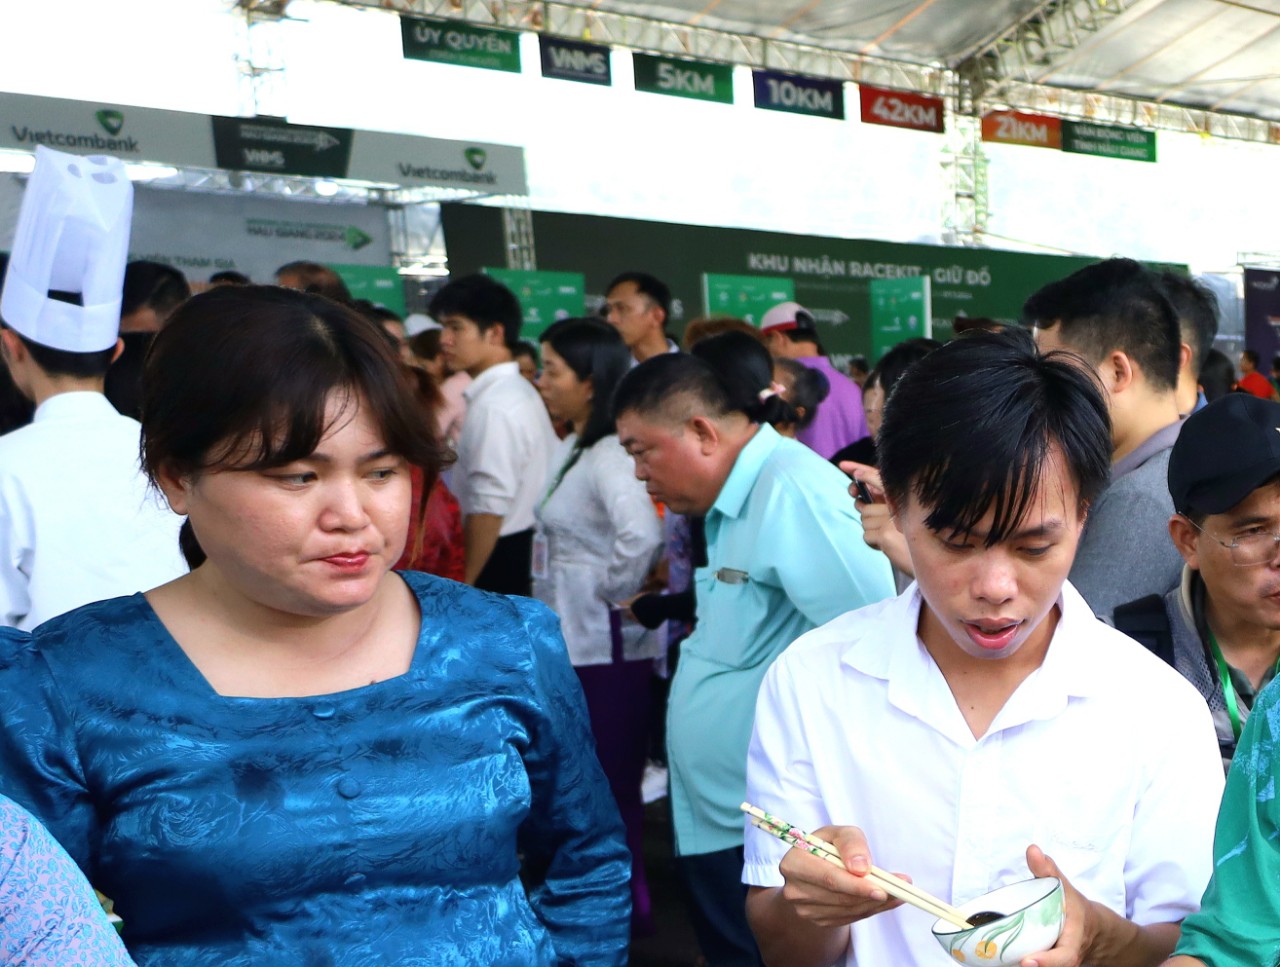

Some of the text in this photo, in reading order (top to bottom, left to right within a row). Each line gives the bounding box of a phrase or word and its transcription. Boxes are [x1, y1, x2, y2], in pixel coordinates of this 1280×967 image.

[550, 46, 608, 73] VNMS
[656, 63, 715, 96] 5KM
[767, 78, 833, 113] 10KM
[871, 96, 937, 128] 42KM
[11, 124, 140, 152] Vietcombank
[995, 114, 1048, 144] 21KM
[398, 162, 496, 185] Vietcombank
[748, 252, 789, 271] KHU
[849, 261, 922, 280] RACEKIT
